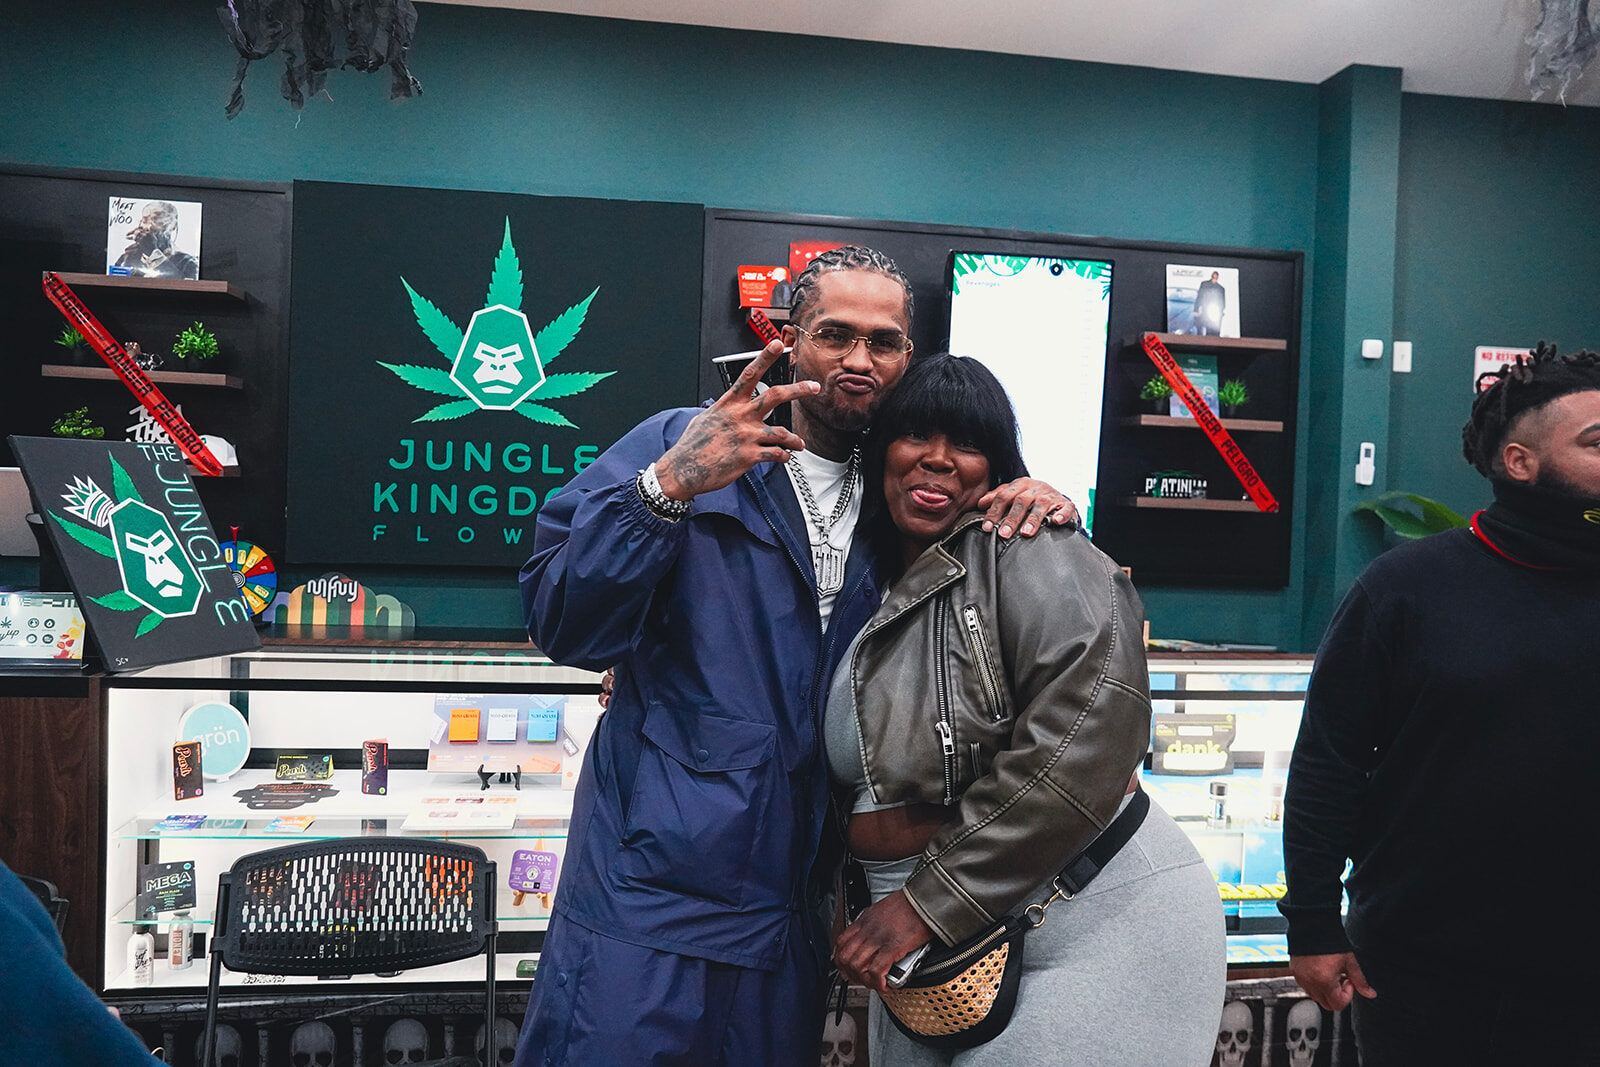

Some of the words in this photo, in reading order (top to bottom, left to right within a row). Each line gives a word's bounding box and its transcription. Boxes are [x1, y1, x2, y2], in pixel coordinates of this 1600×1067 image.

[109, 215, 133, 227] WOO
[103, 343, 154, 398] DANGER
[153, 401, 203, 456] PELIGRO
[1184, 388, 1221, 436] DANGER
[1221, 440, 1258, 488] PELIGRO
[137, 445, 180, 462] THE
[388, 439, 599, 474] JUNGLE
[519, 853, 552, 863] EATON
[146, 871, 193, 893] MEGA
